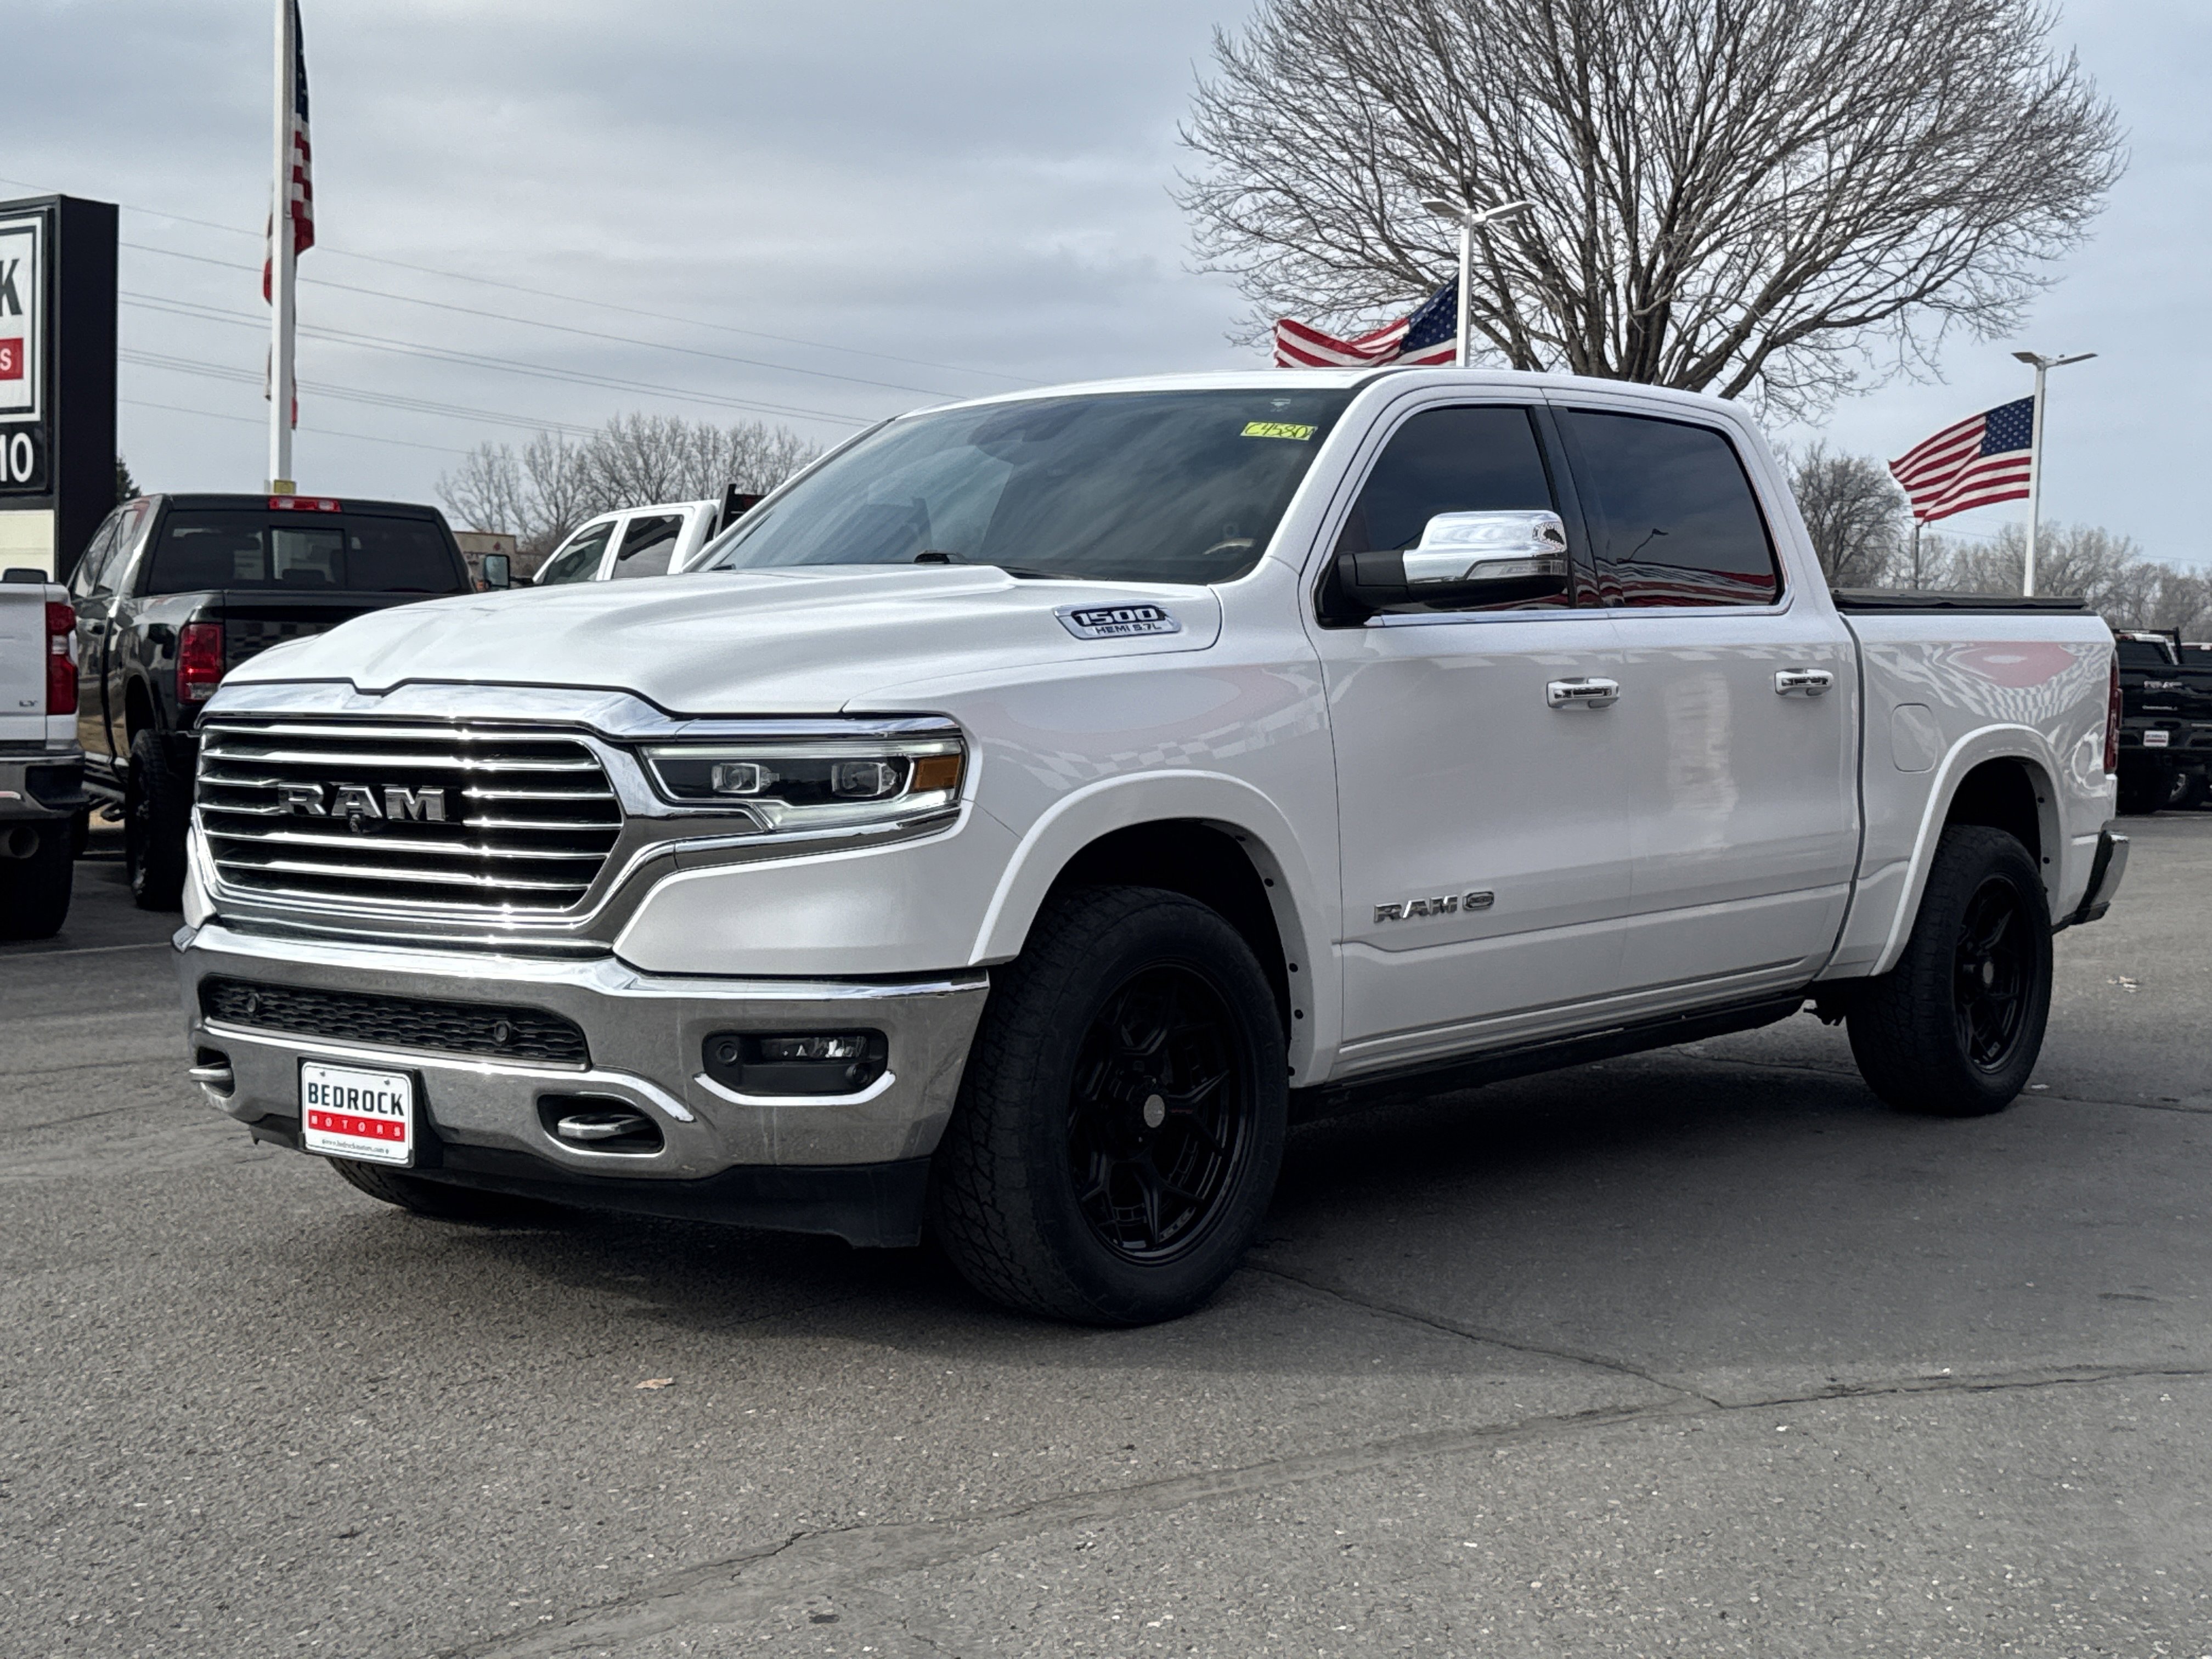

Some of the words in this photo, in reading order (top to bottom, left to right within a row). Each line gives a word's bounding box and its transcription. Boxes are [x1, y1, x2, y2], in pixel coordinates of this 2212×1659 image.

[1075, 608, 1159, 625] 1500
[1094, 625, 1131, 634] HEMI
[276, 782, 446, 822] RAM
[1373, 894, 1458, 924] RAM
[308, 1082, 404, 1116] BEDROCK
[311, 1115, 401, 1137] MOTORS
